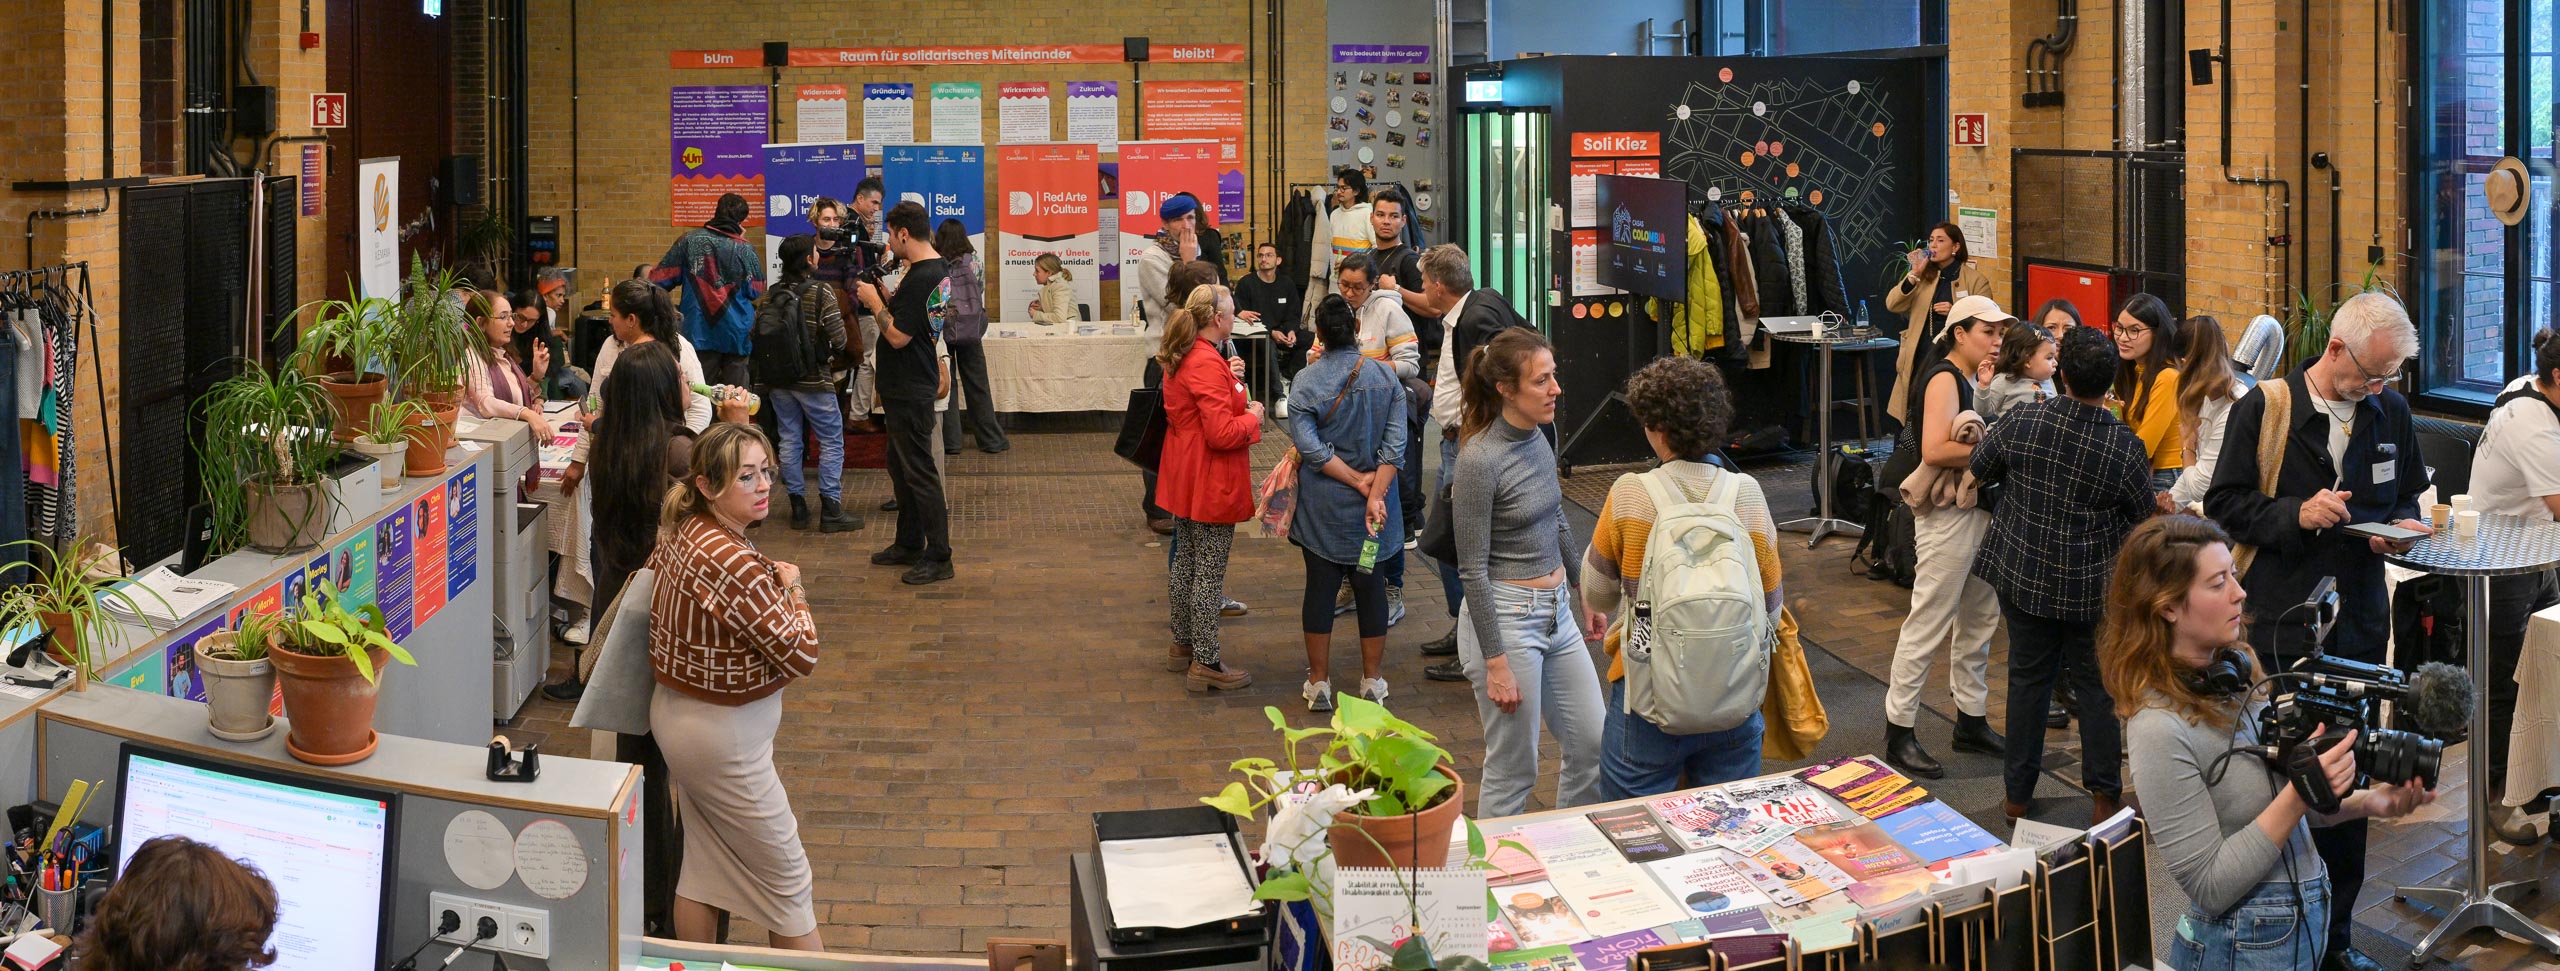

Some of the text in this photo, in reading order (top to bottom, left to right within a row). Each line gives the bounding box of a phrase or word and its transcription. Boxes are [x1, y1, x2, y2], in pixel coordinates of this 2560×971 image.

[704, 53, 733, 64] bUm
[840, 48, 1072, 62] Raum für solidarisches Miteinander
[1173, 48, 1215, 59] bleibt!
[1583, 137, 1647, 151] Soli Kiez
[936, 193, 956, 204] Red
[1043, 192, 1087, 202] Red Arte
[1160, 192, 1178, 201] Re
[936, 205, 965, 216] Salud
[1043, 203, 1088, 216] y Cultura
[1632, 229, 1665, 245] COLOMBIA
[1066, 248, 1090, 256] Únete
[431, 493, 441, 504] Chris
[395, 516, 405, 527] Sina
[310, 564, 327, 579] Marley
[258, 595, 274, 612] Marie
[130, 673, 145, 689] Eva
[1920, 828, 1946, 837] Projekt
[1878, 917, 1902, 932] Mehr
[1597, 934, 1658, 954] TION
